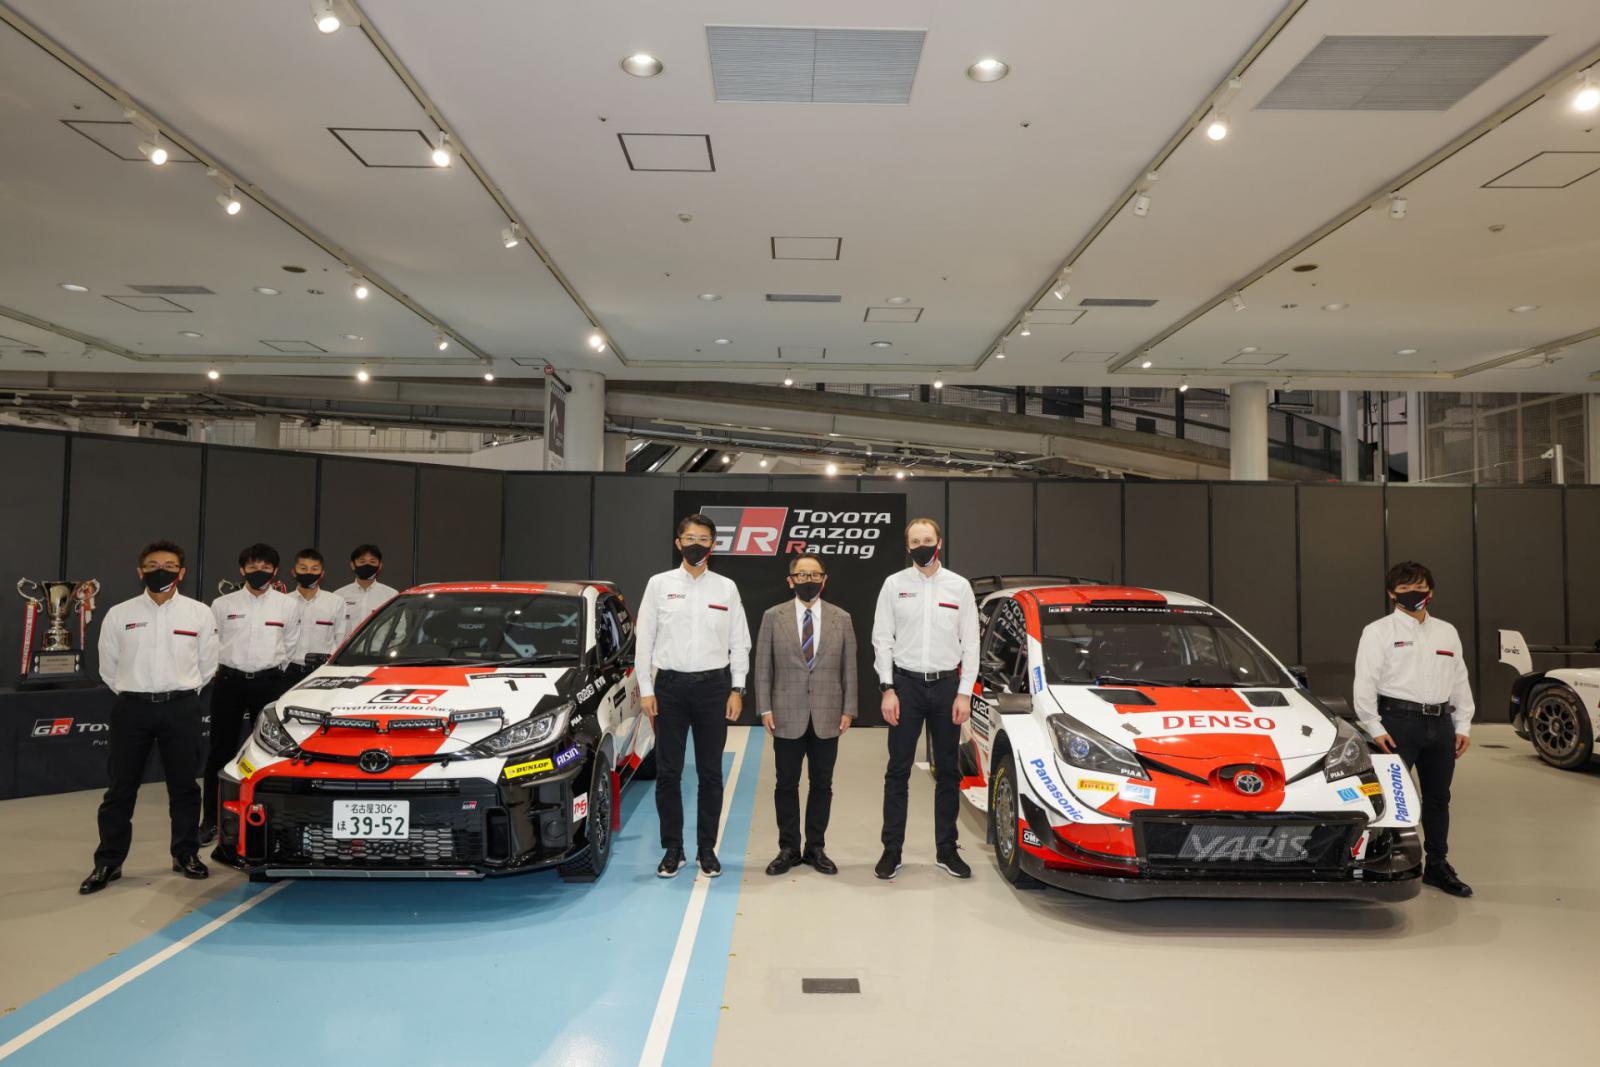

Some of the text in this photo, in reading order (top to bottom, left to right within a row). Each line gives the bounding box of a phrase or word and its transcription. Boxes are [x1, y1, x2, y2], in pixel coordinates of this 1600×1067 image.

[794, 509, 891, 524] TOYOTA
[789, 525, 880, 539] GAZOO
[785, 541, 875, 559] Racing
[504, 679, 518, 692] 1
[371, 693, 439, 704] GR
[1162, 715, 1276, 730] DENSO
[34, 724, 69, 736] GR
[516, 762, 549, 774] DUNLOP
[1120, 768, 1141, 777] PIAA
[1330, 770, 1345, 779] PIAA
[1030, 758, 1084, 821] Panasonic
[1390, 763, 1411, 823] Panasonic
[337, 816, 405, 836] ほ 39-52
